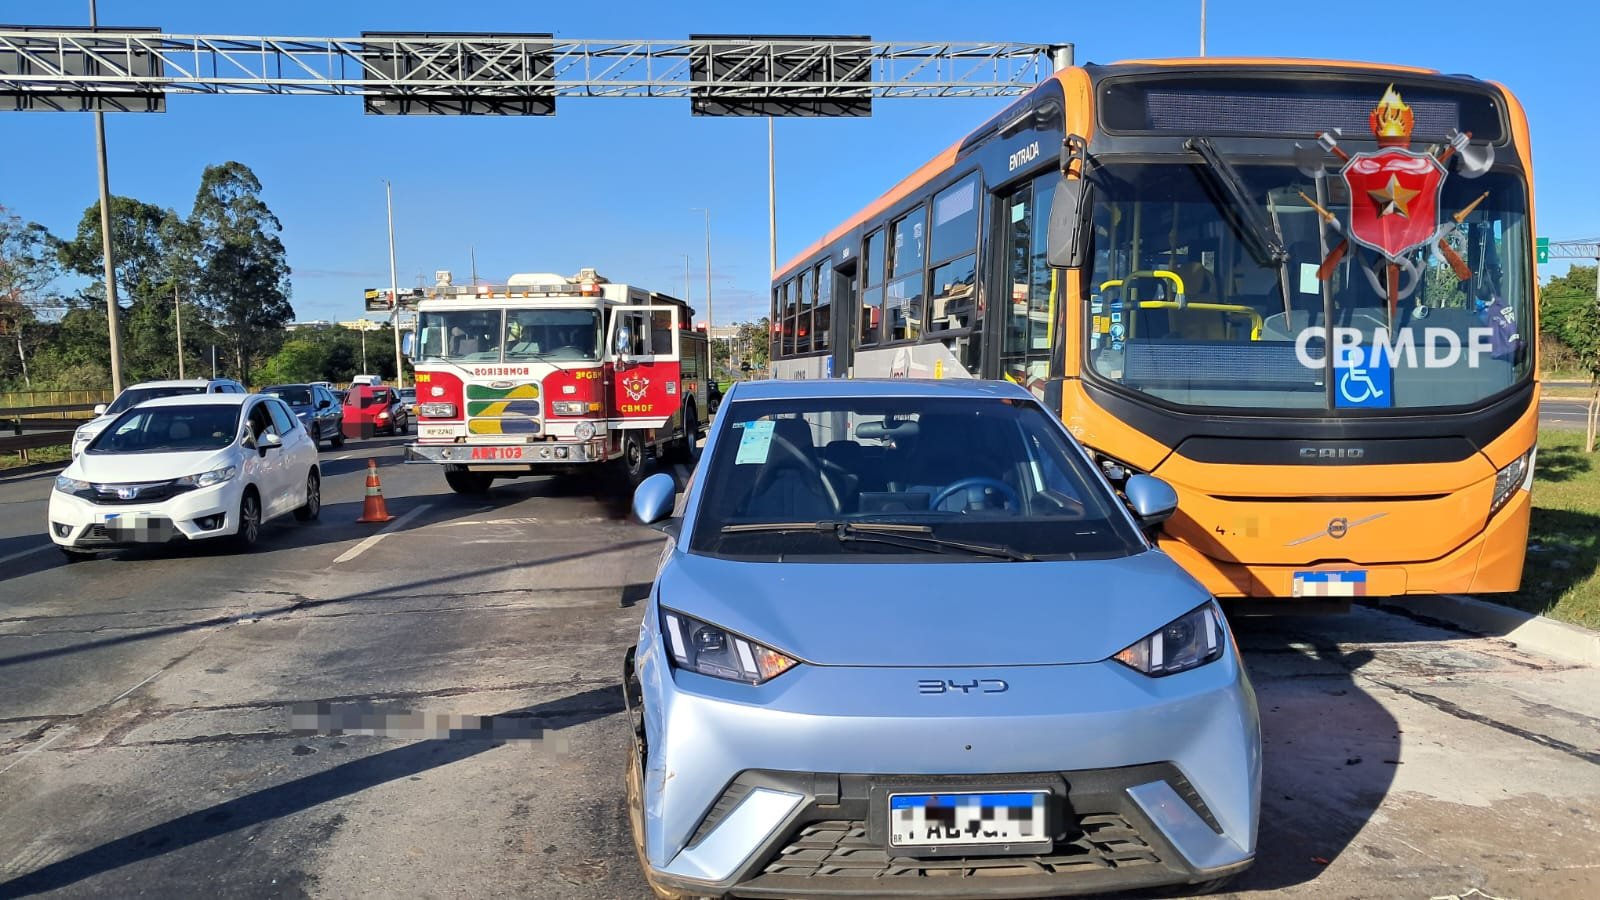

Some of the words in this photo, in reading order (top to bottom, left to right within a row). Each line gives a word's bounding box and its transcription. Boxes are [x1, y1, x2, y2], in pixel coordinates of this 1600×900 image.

[1009, 141, 1039, 171] ENTRADA
[621, 404, 653, 413] CBMDF
[1300, 448, 1364, 458] CAIO
[917, 679, 1009, 694] BYD
[893, 834, 903, 843] BR
